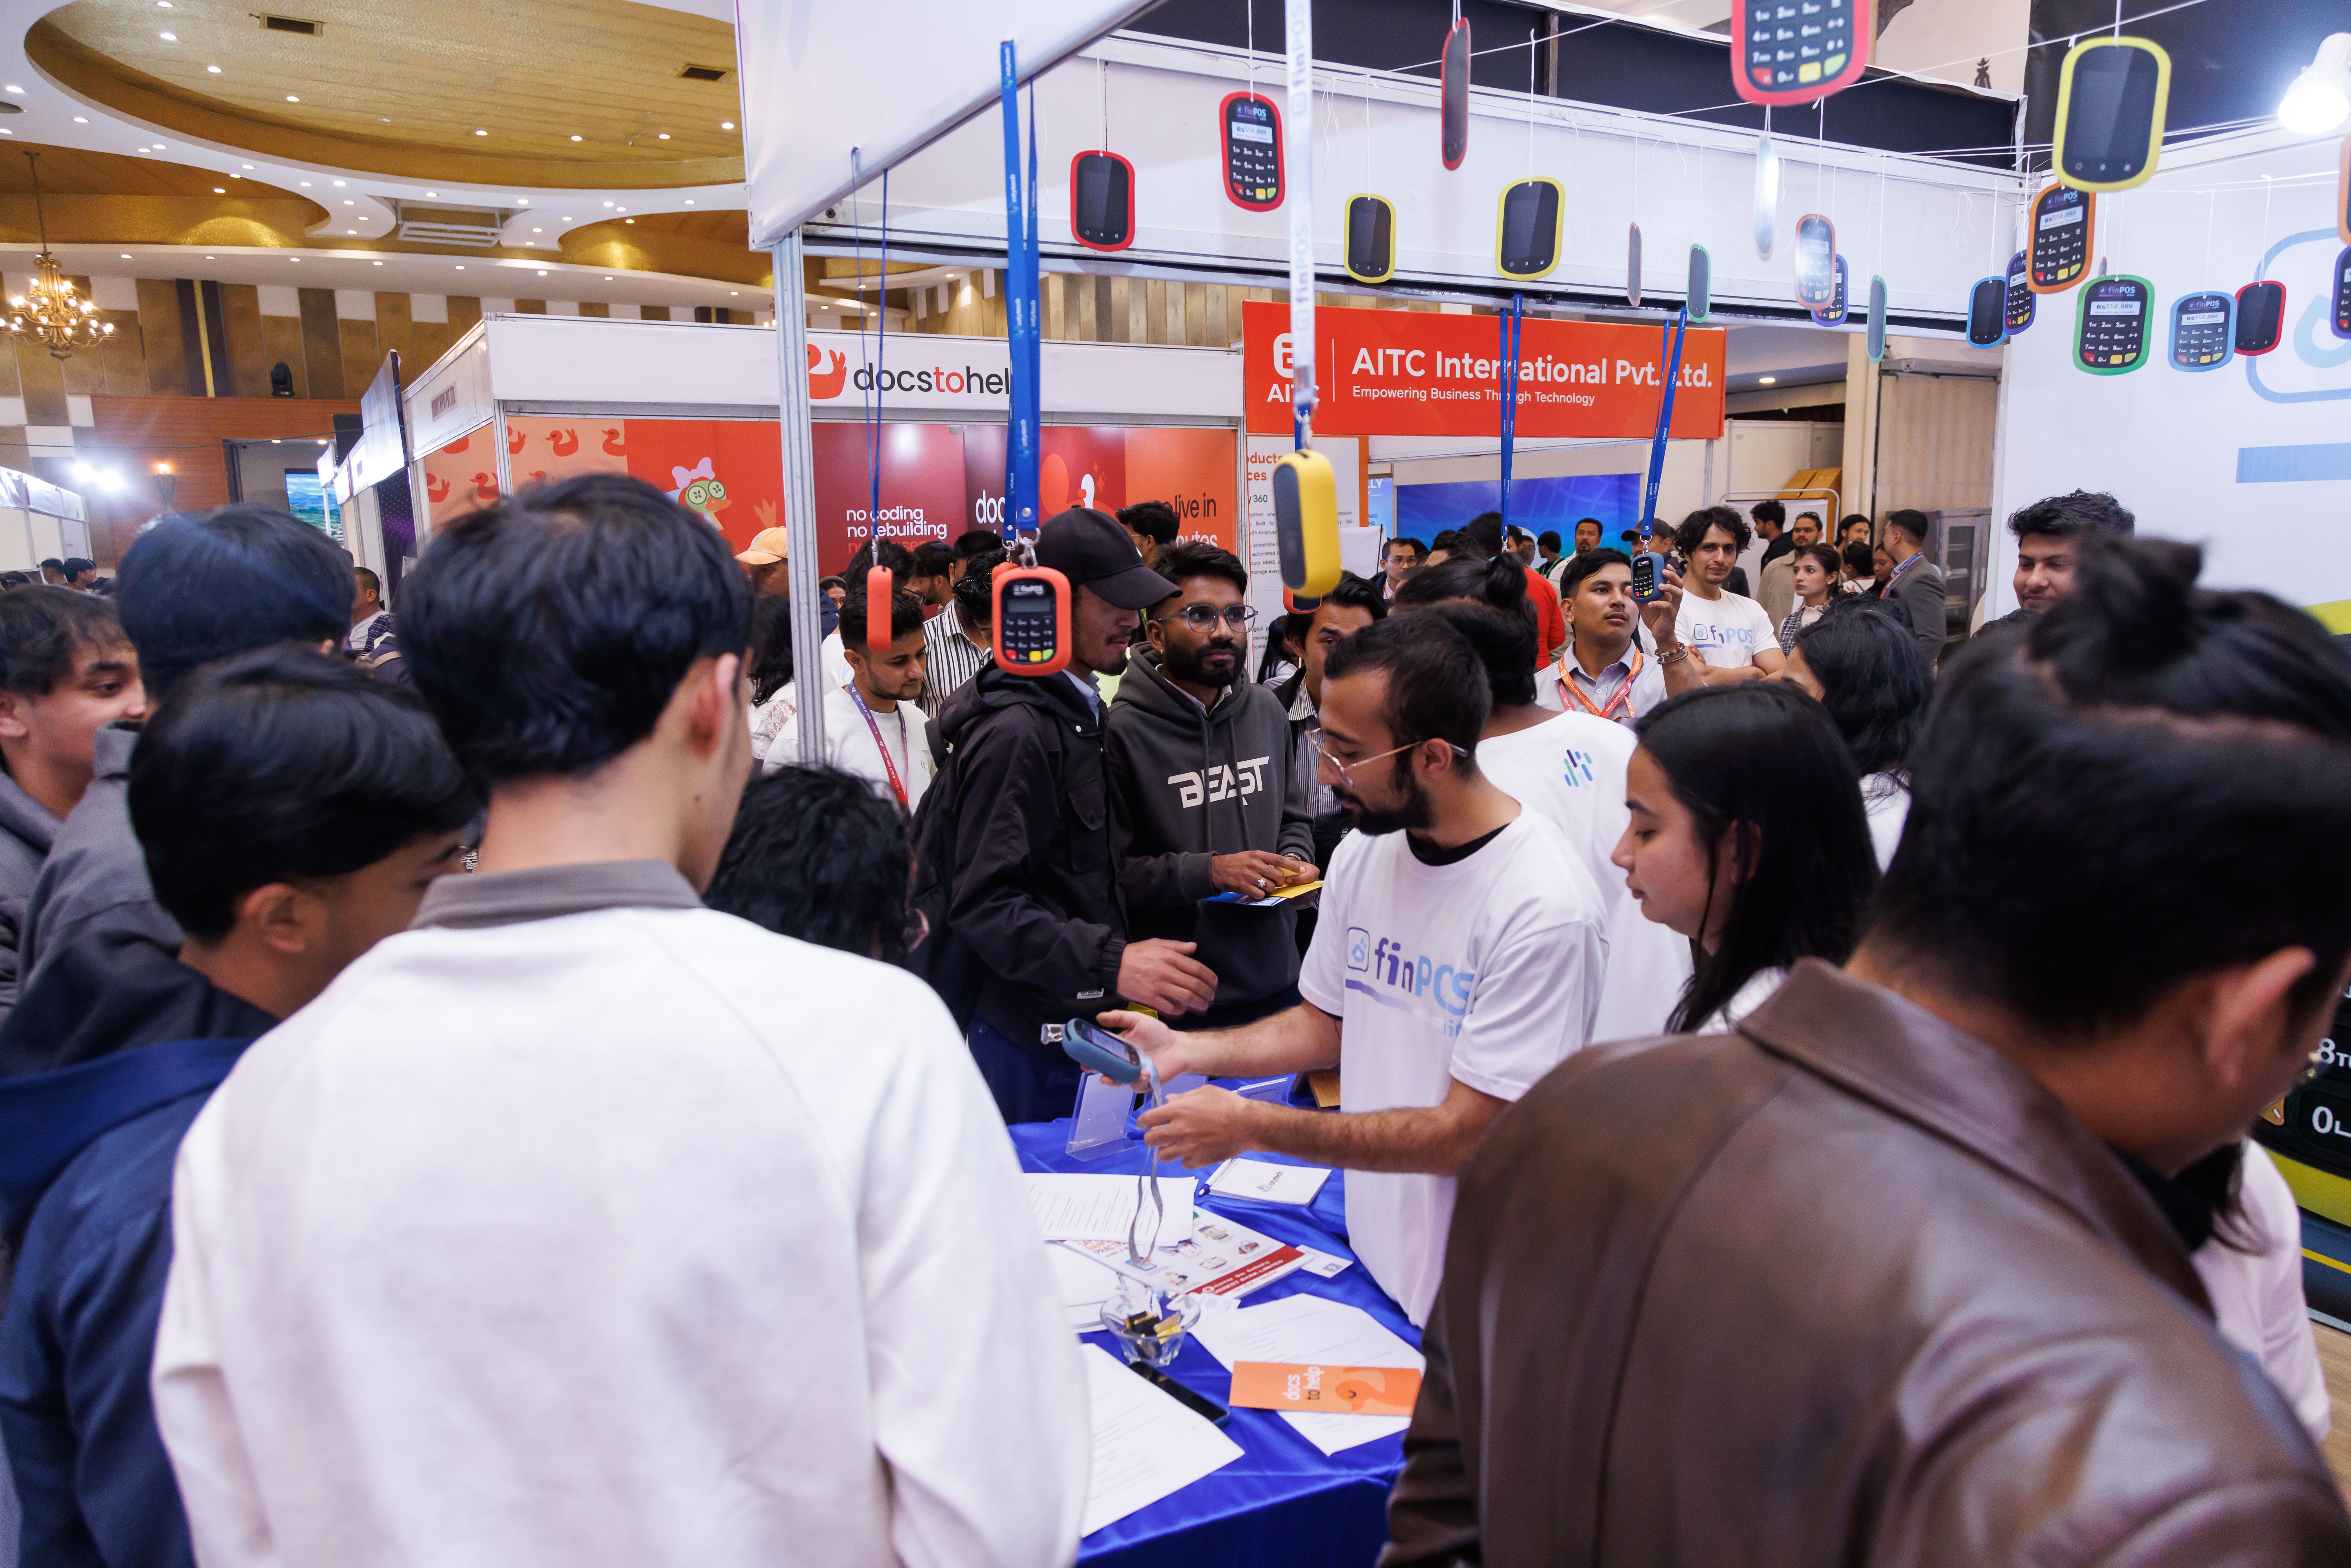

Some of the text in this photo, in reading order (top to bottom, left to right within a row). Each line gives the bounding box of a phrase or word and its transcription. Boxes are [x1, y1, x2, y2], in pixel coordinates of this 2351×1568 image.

[1351, 347, 1425, 377] AITC
[1616, 360, 1660, 386] Pvt.
[853, 362, 1010, 395] docstohel
[1267, 383, 1320, 403] AI
[1353, 386, 1595, 406] Empowering Business Thrgh Technology
[975, 490, 1005, 524] doc
[1203, 492, 1216, 517] in
[1253, 494, 1268, 503] 360
[846, 509, 867, 521] no
[847, 521, 947, 539] no ebuilding
[1710, 625, 1753, 644] fnPOS
[1565, 676, 1599, 715] AITC INTERNATIONAL
[1606, 702, 1614, 712] NAS-IT
[1168, 756, 1269, 808] BEAST
[1282, 1374, 1301, 1401] docs
